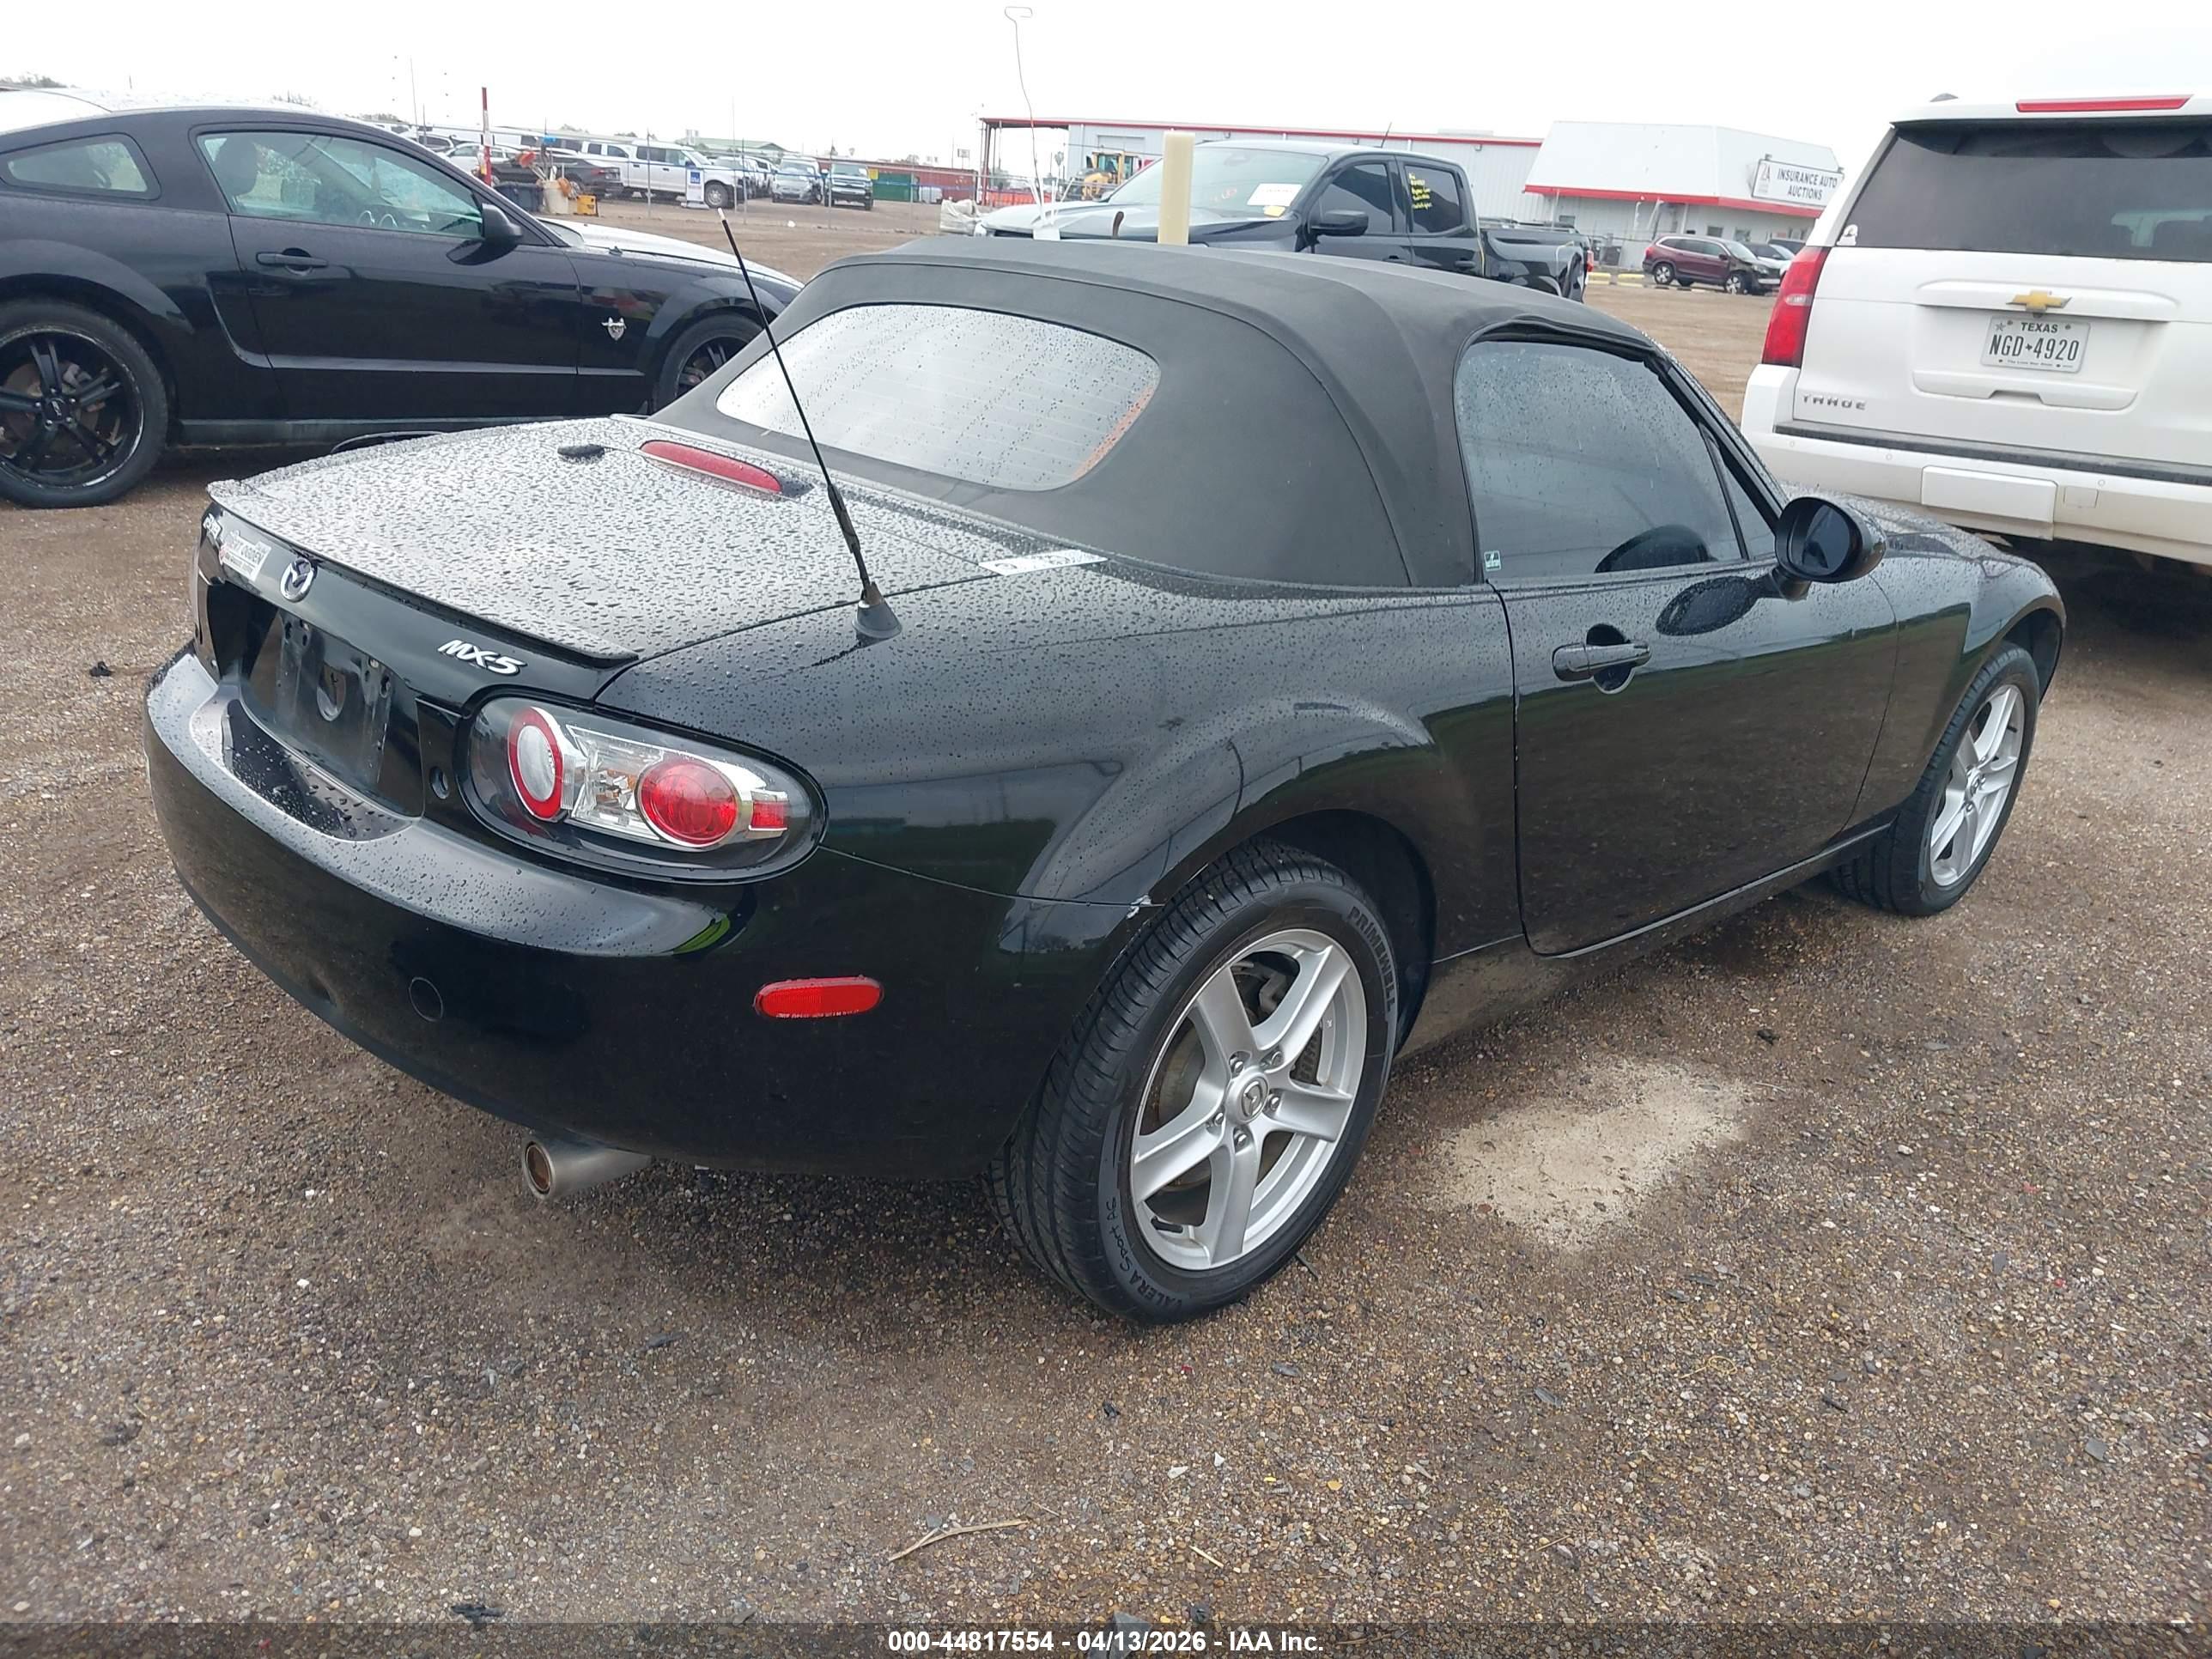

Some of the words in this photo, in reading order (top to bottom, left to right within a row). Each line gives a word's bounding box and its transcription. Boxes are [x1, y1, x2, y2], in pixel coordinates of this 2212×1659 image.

[1777, 167, 1819, 186] INSURANCE
[1819, 173, 1838, 189] AUTO
[1787, 185, 1822, 201] AUCTIONS
[2021, 321, 2059, 334] TEXAS
[1802, 393, 1868, 411] TAHOE
[436, 639, 529, 676] MX-5
[1346, 906, 1396, 1013] PRIMEWELL
